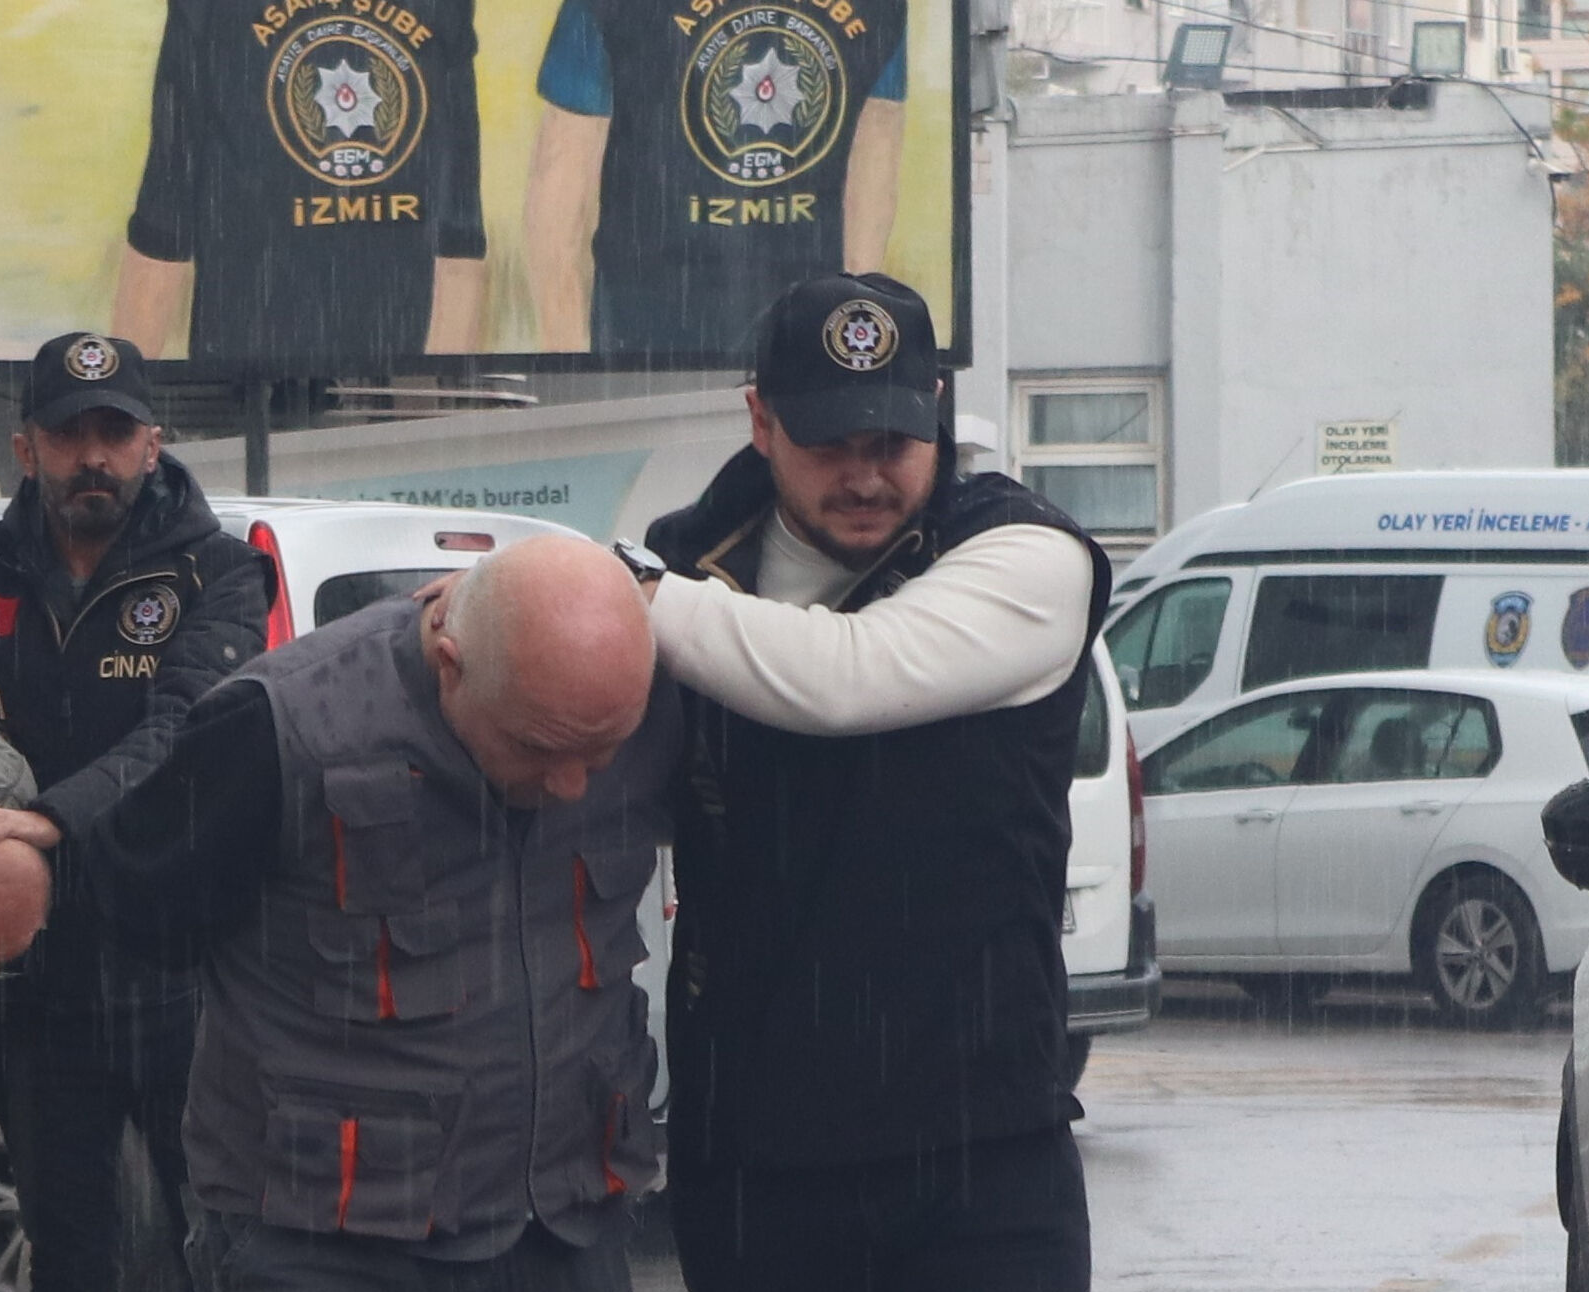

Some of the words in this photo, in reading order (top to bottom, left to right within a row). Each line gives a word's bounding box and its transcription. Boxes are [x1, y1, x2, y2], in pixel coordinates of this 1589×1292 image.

[333, 149, 371, 164] EGM
[743, 152, 782, 167] EGM
[293, 194, 420, 227] İZMİR
[689, 193, 816, 227] İZMİR
[1325, 426, 1357, 436] OLAY
[483, 484, 570, 507] burada!
[1378, 514, 1427, 531] OLAY
[1432, 508, 1474, 531] YERİ
[1477, 508, 1572, 531] İNCELEME
